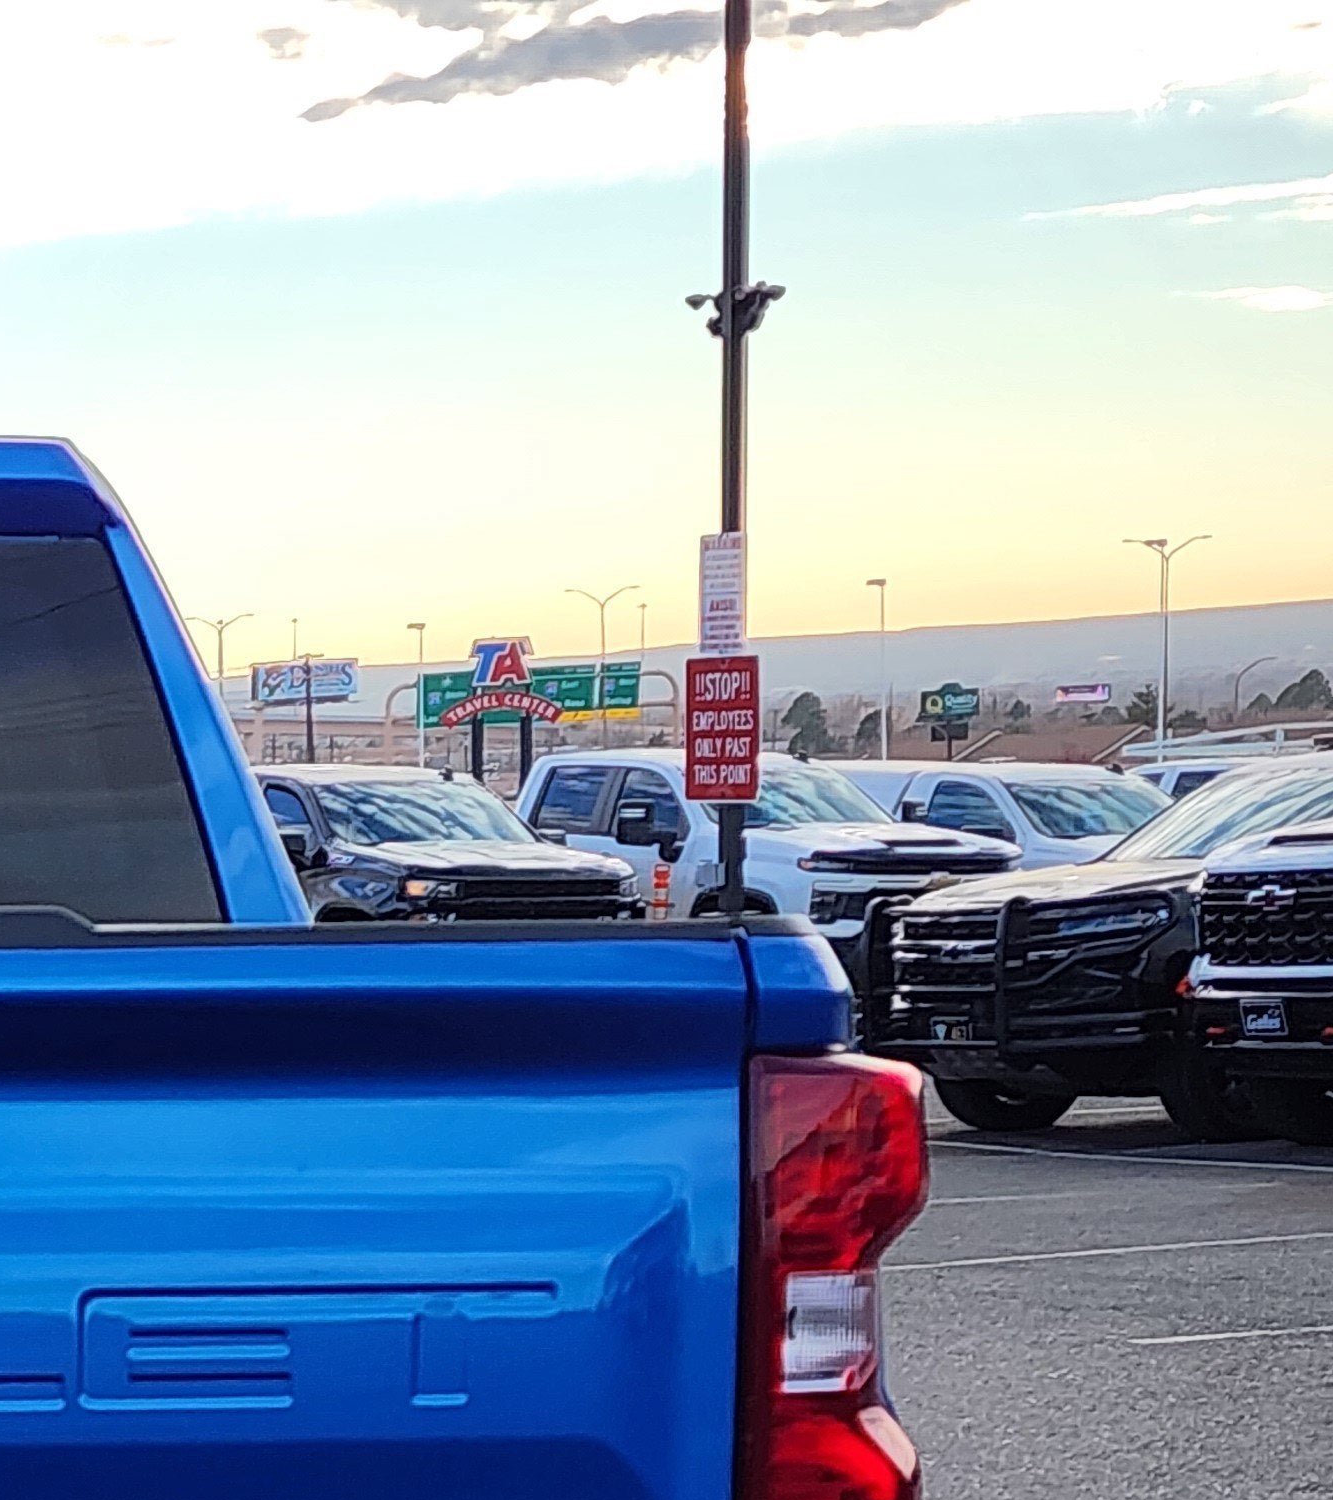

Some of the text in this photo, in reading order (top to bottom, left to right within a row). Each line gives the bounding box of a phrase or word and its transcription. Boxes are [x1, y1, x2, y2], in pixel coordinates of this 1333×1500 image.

[472, 639, 532, 687] TA
[694, 670, 751, 702] !!STOP!!
[445, 693, 557, 722] TRAVEL CENTER
[693, 709, 754, 732] EMPLOYEES
[695, 737, 752, 758] ONLY PAST
[693, 763, 752, 786] THIS POINT
